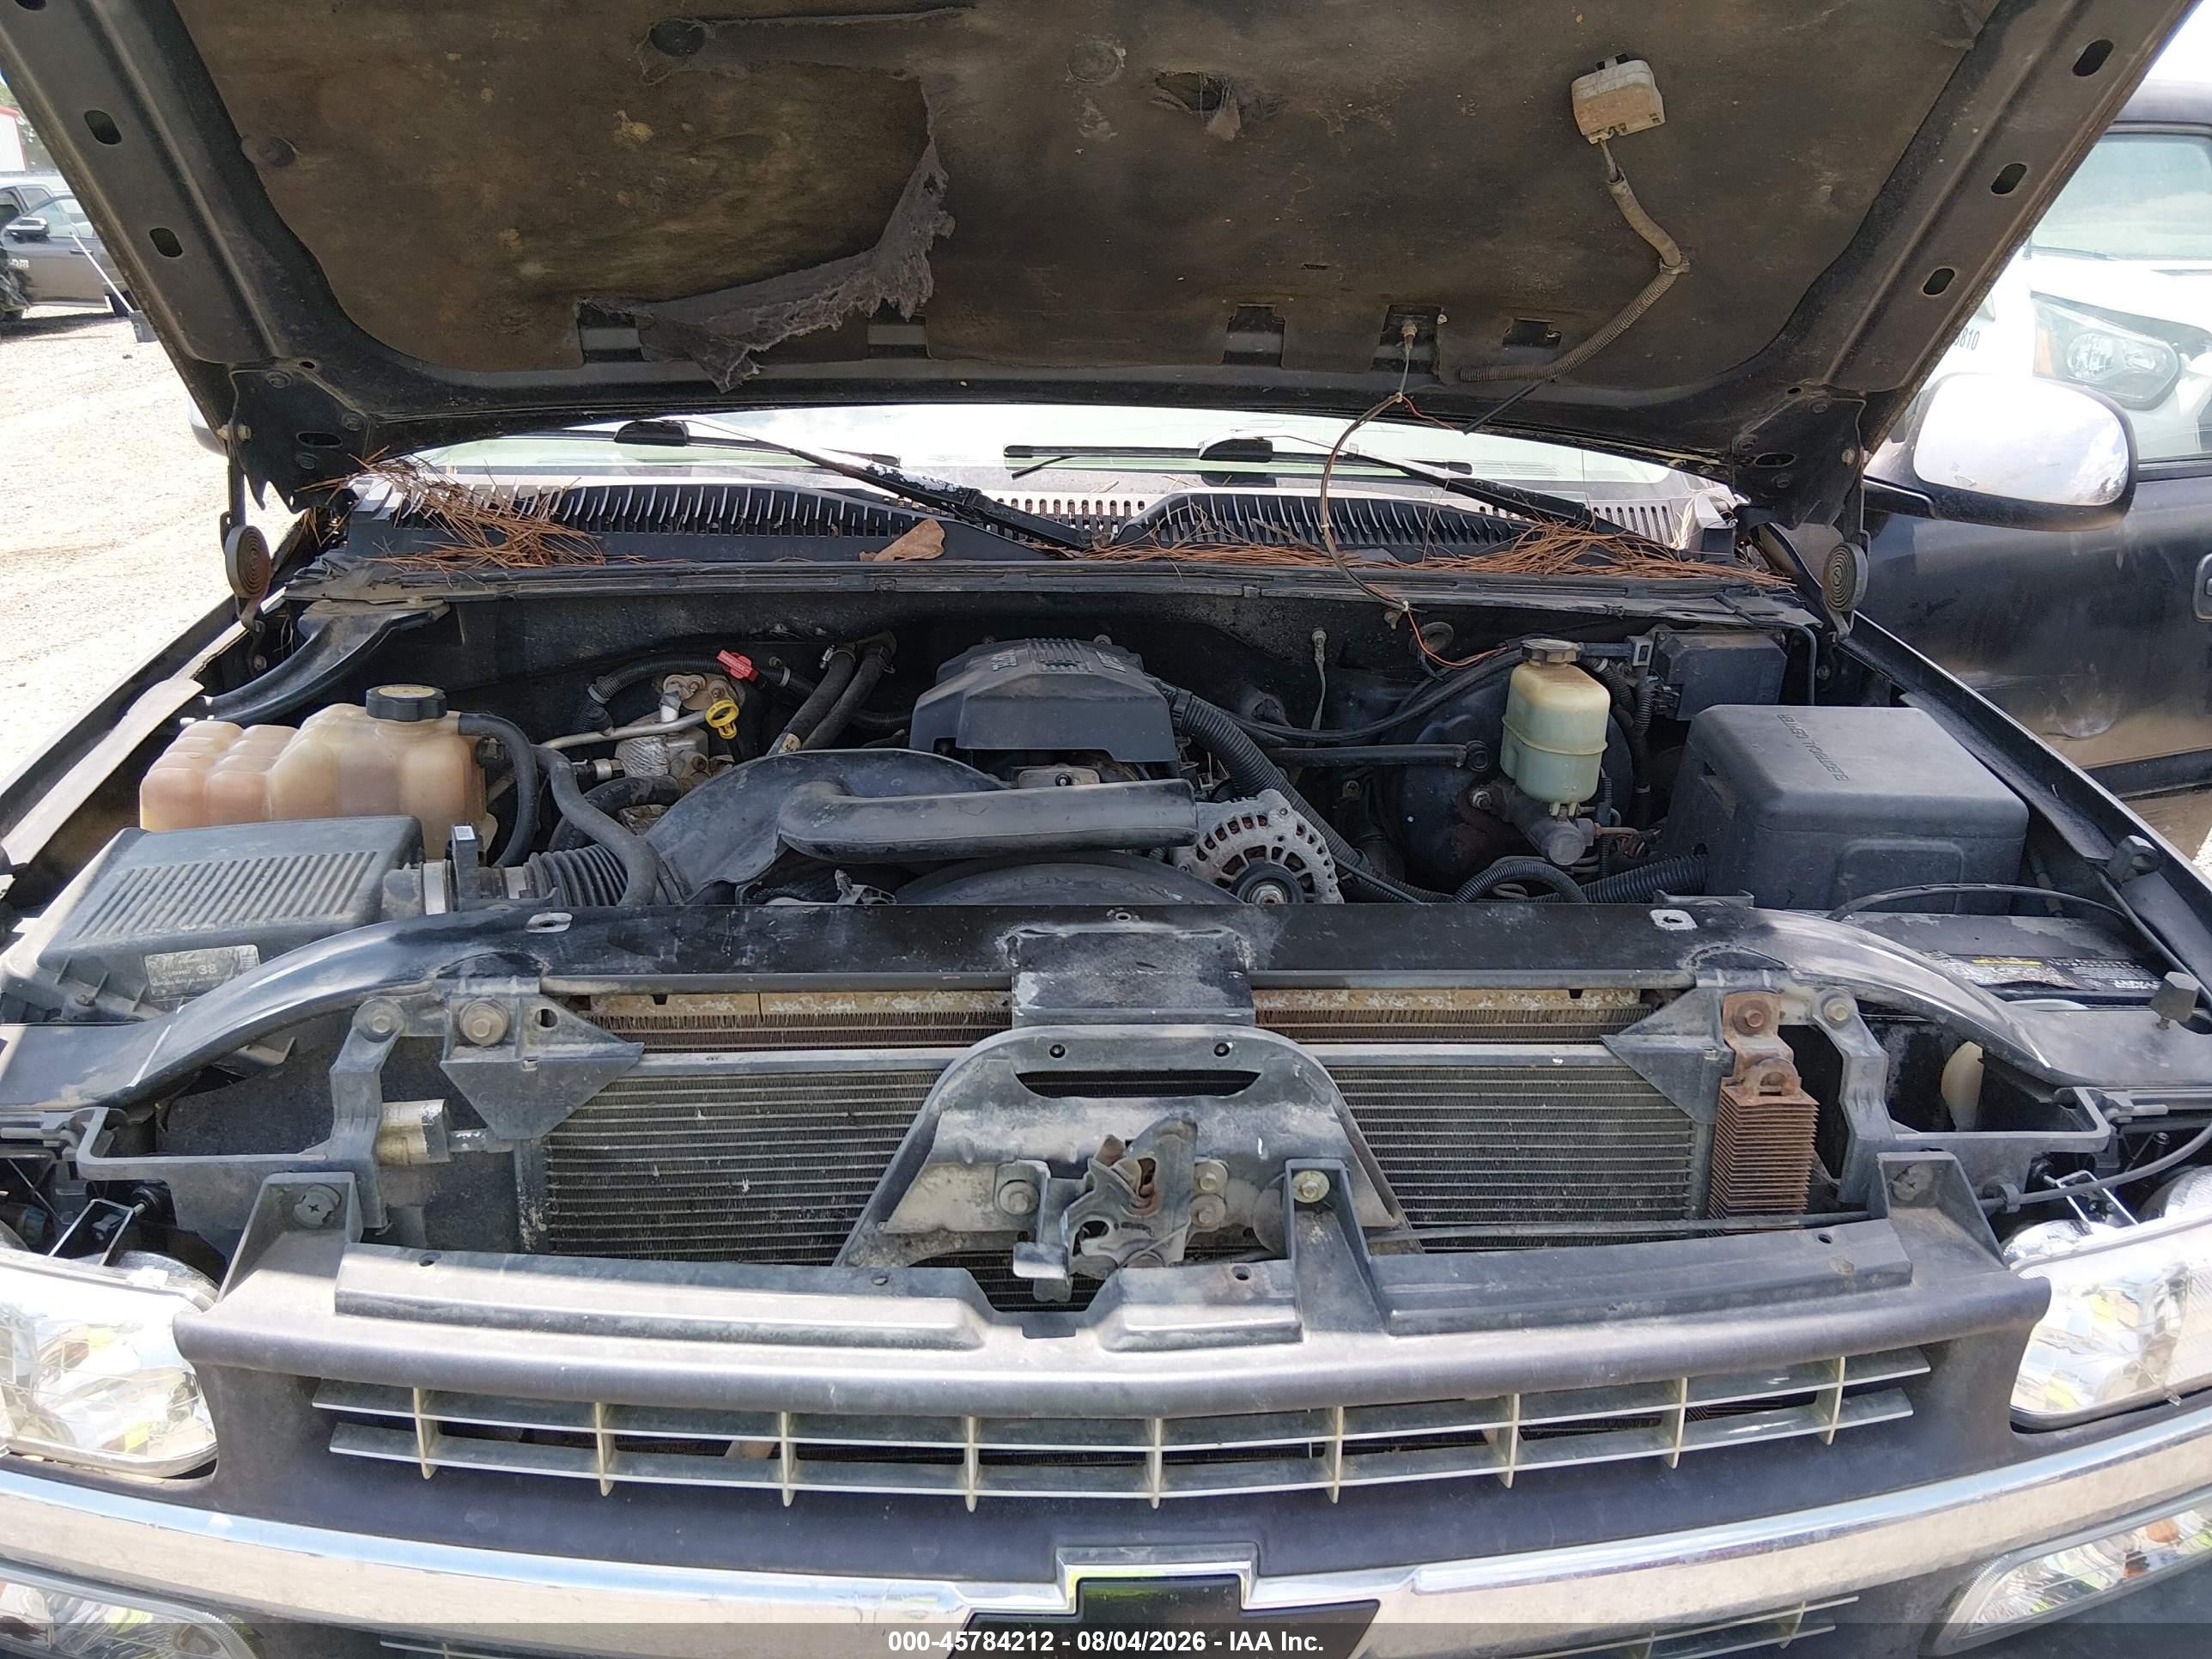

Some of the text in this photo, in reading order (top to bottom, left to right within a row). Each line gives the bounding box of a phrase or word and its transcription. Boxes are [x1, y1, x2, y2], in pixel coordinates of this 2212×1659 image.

[1777, 714, 1850, 781] ELECTRICAL CENTER
[198, 963, 218, 975] 38
